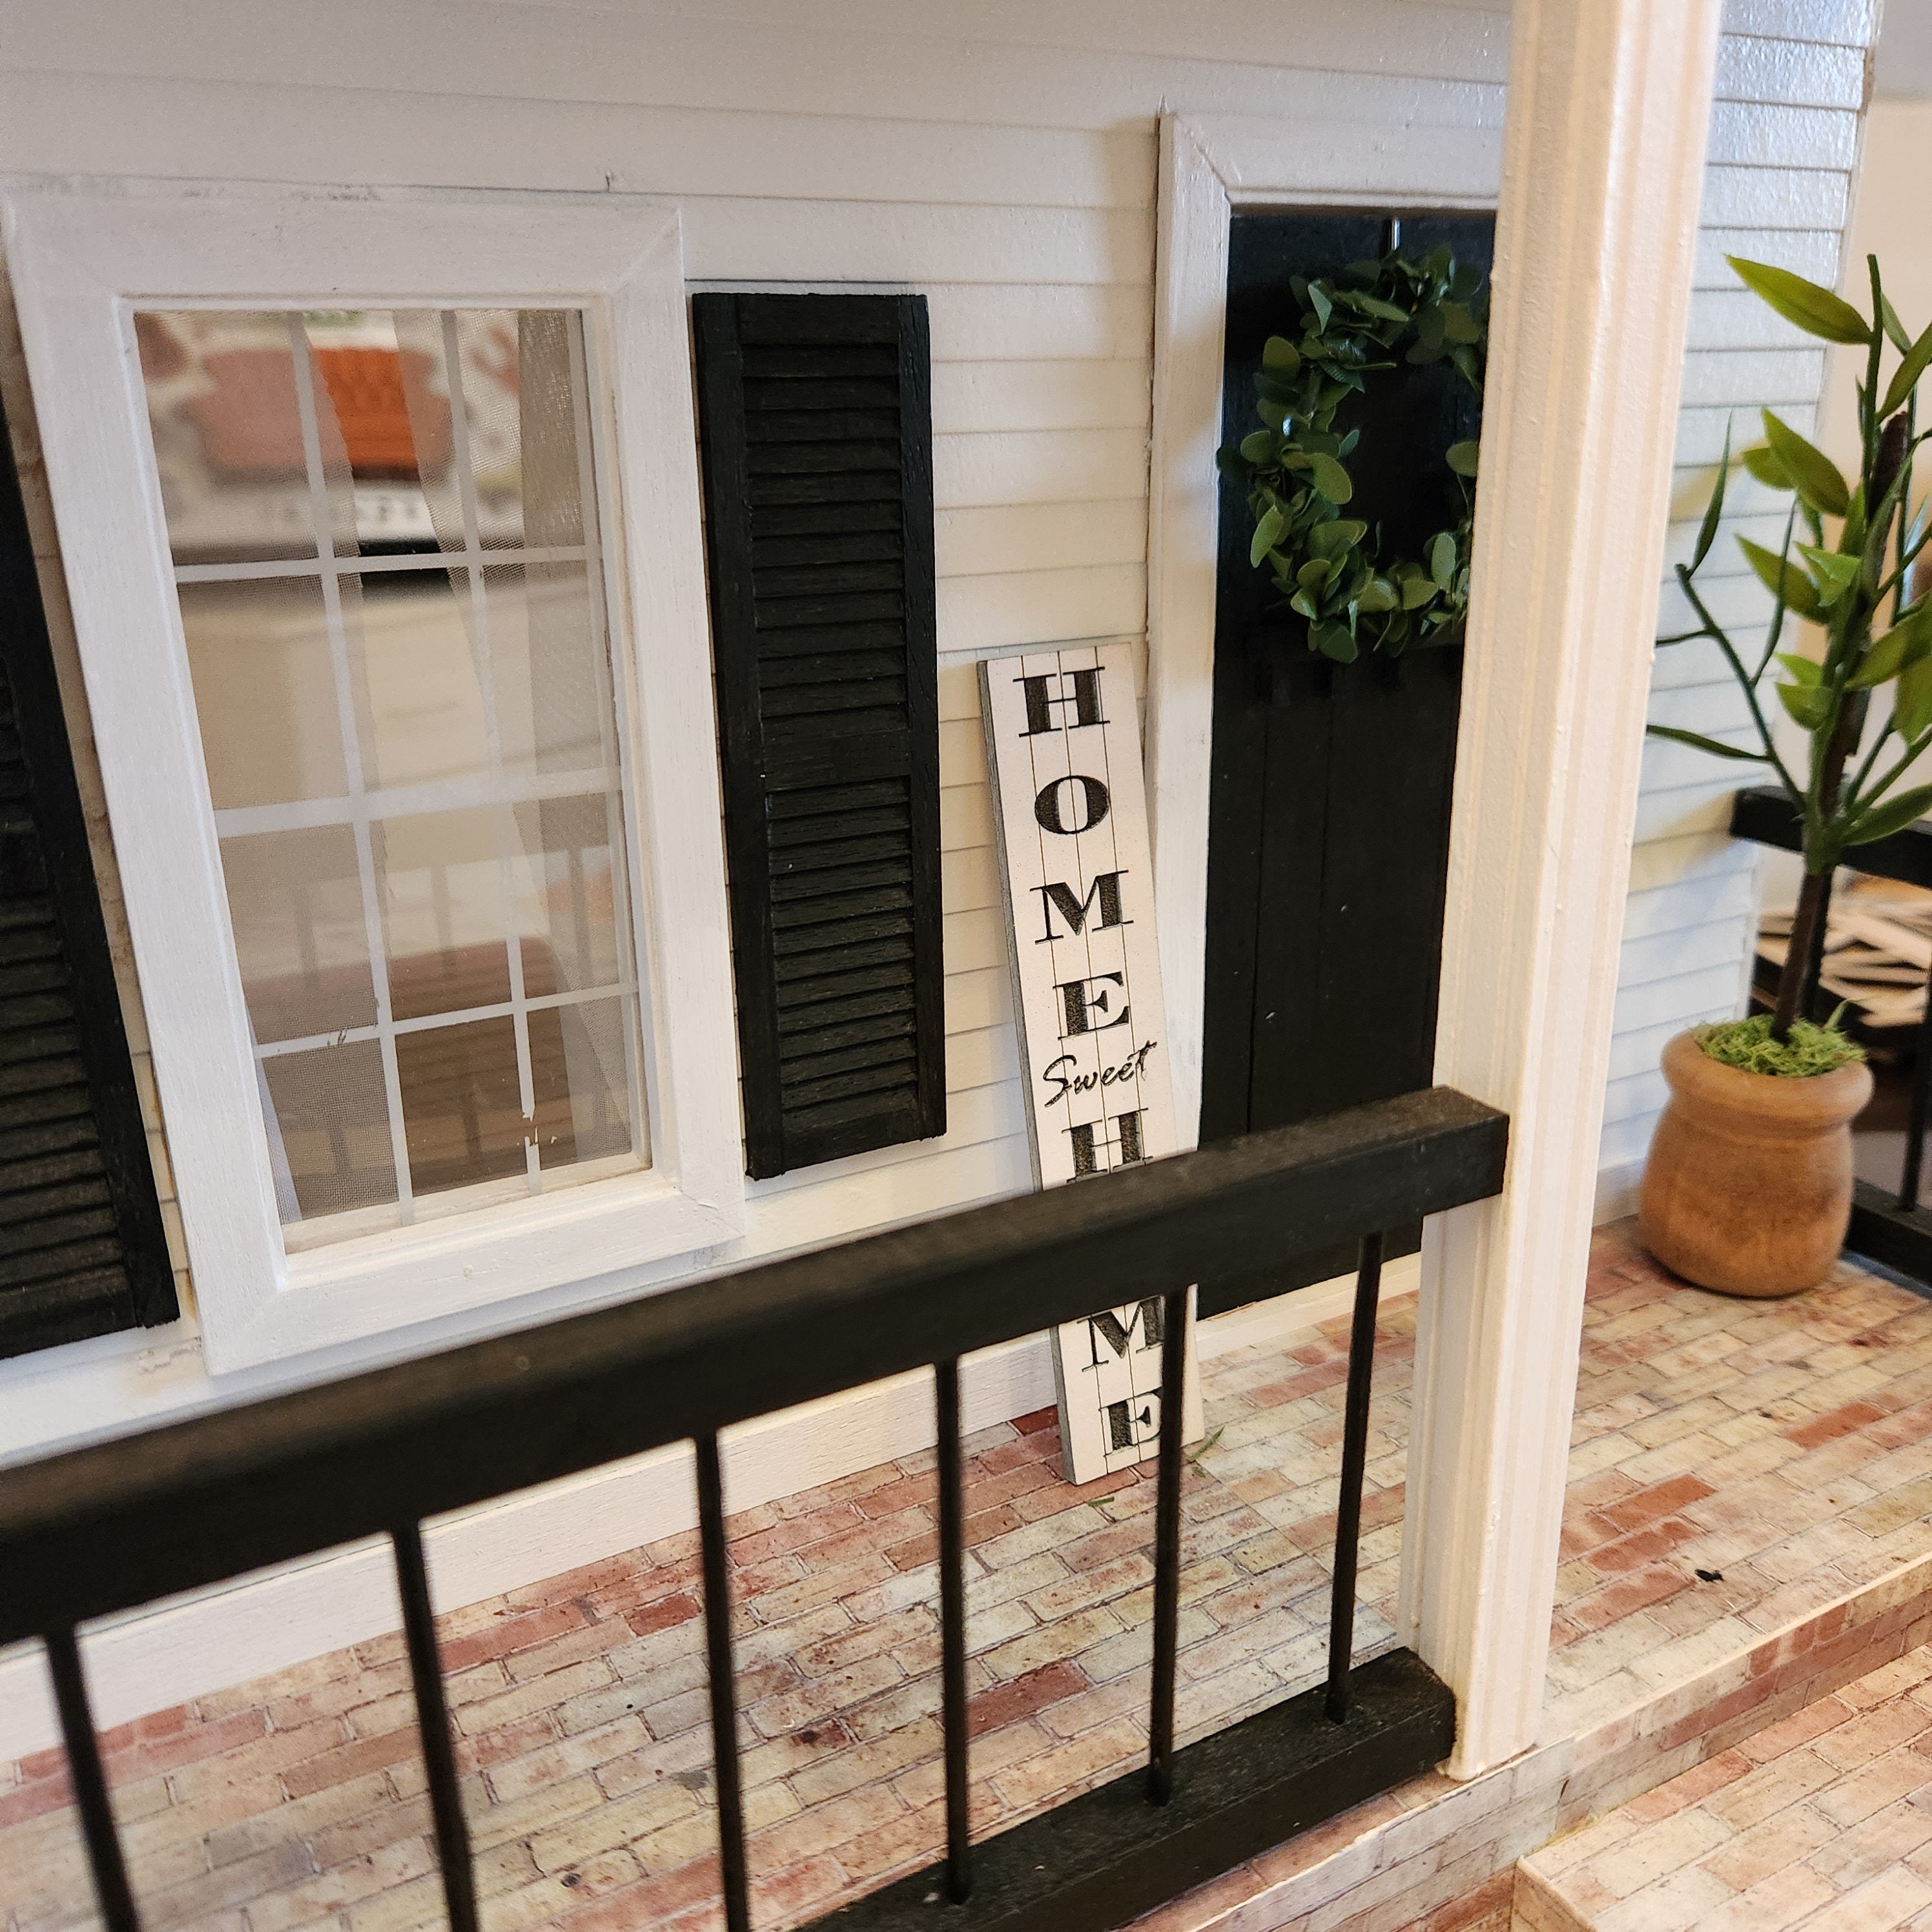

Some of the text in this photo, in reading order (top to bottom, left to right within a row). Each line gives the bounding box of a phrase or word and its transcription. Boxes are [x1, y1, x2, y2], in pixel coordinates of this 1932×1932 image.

[1013, 666, 1134, 1040] HOME
[1043, 1040, 1158, 1107] Sweet
[1061, 1107, 1164, 1457] HME
